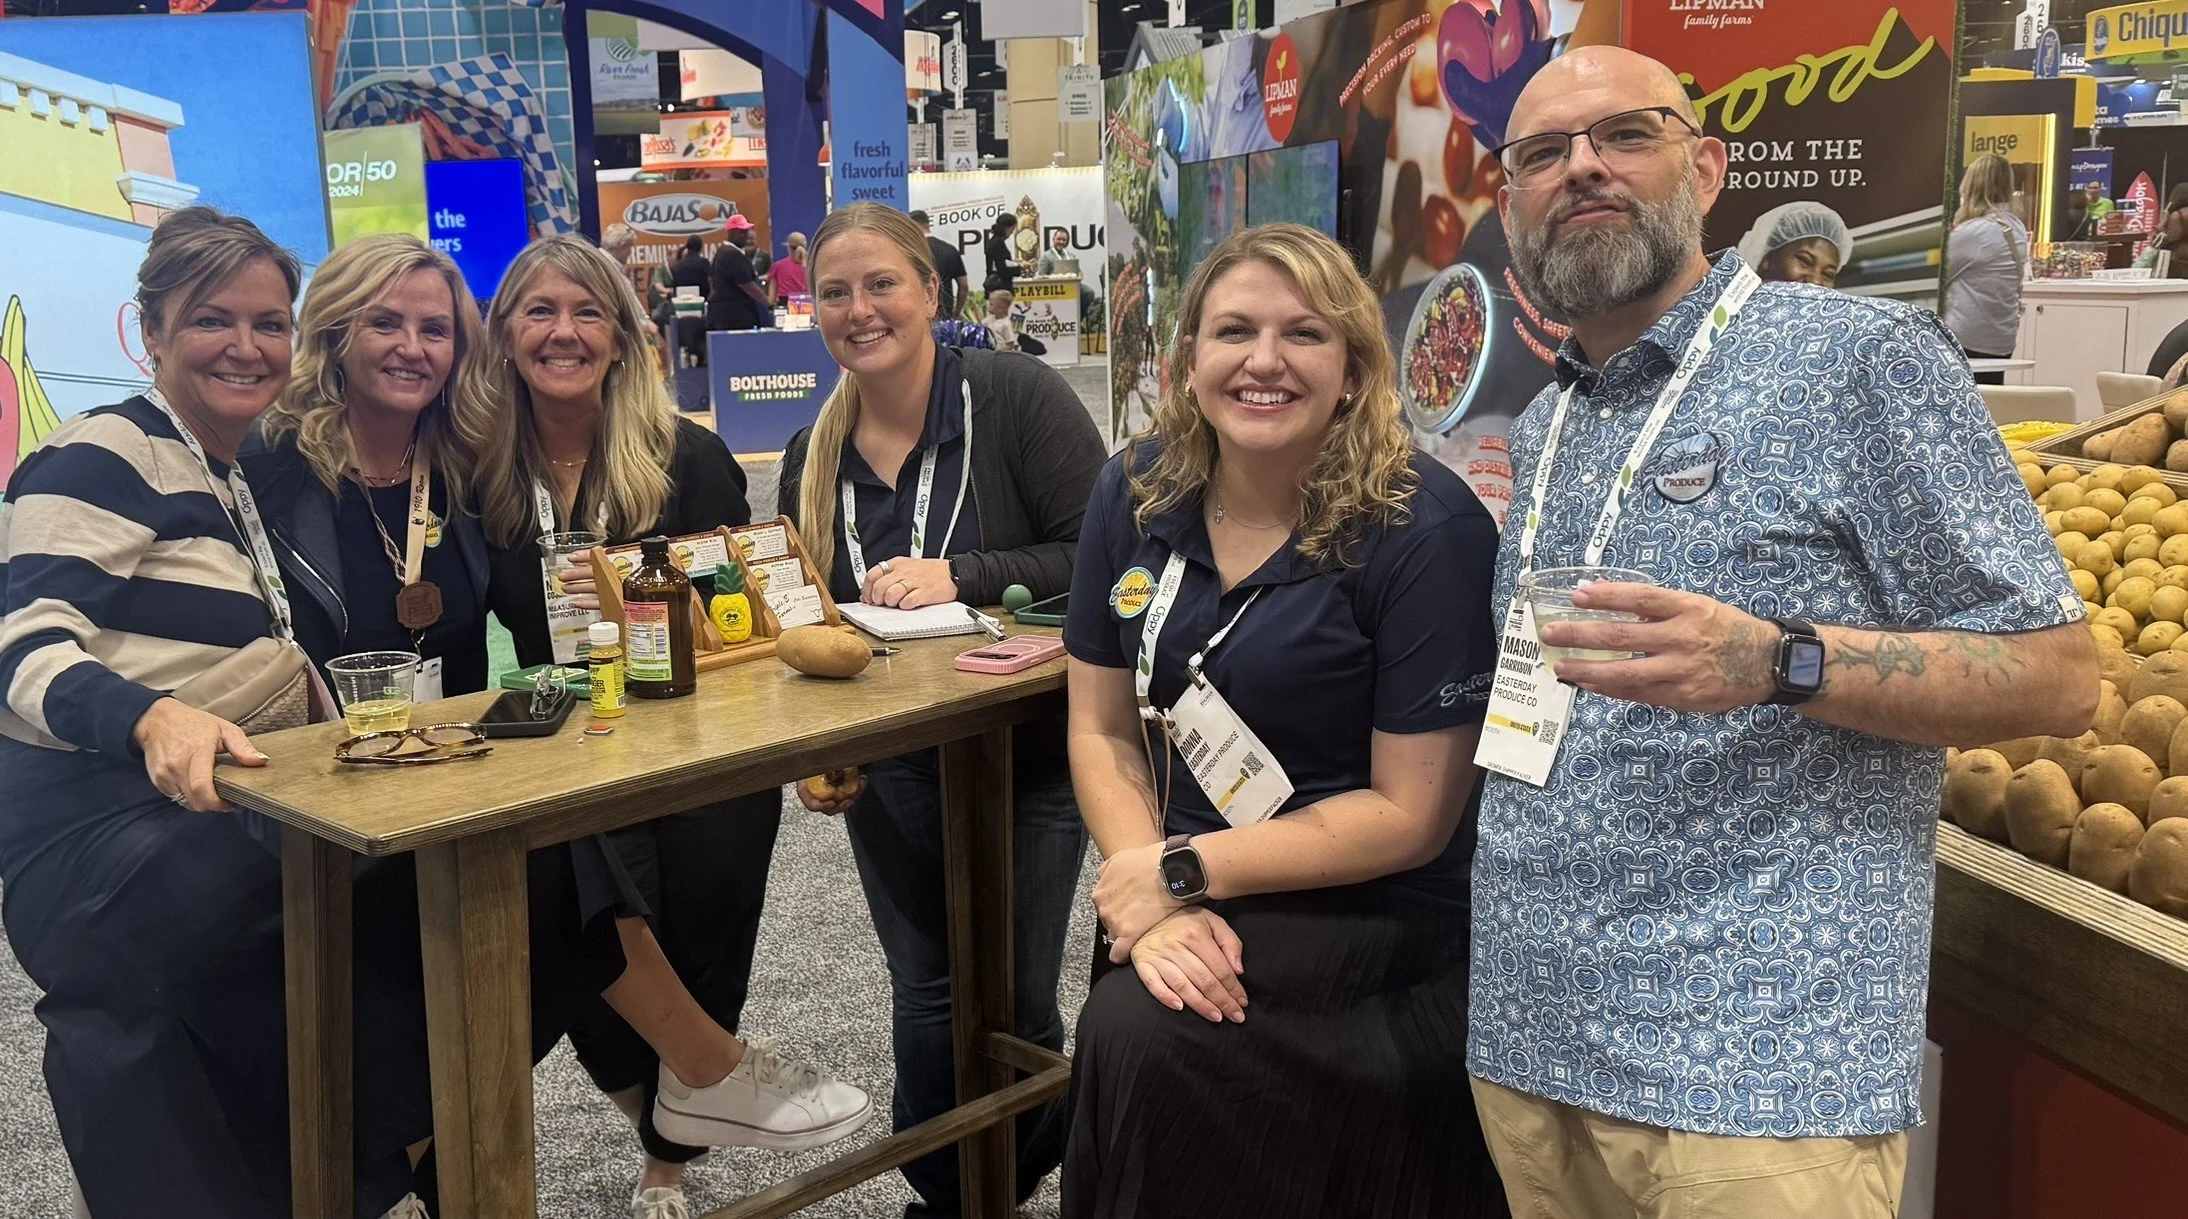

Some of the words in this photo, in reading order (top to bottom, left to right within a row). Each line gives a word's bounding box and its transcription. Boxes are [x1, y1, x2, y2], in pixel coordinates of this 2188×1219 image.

[1684, 14, 1718, 30] family
[1719, 14, 1753, 30] farms
[1398, 43, 1417, 61] NEED
[1265, 78, 1298, 103] LIPMAN
[1339, 62, 1368, 108] PRECISION
[853, 140, 891, 158] fresh
[1722, 140, 1794, 162] ROM
[1806, 139, 1863, 161] THE
[841, 160, 904, 179] flavorful
[1830, 169, 1867, 187] UP.
[328, 184, 360, 197] 2024
[851, 184, 896, 201] sweet
[434, 208, 467, 229] the
[939, 208, 982, 226] BOOK
[985, 203, 1006, 218] OF
[1012, 284, 1066, 298] PLAYBILL
[1676, 346, 1702, 380] Oppy
[730, 372, 817, 392] BOLTHOUSE
[744, 391, 773, 401] FRESH
[774, 390, 804, 400] FOODS
[1663, 477, 1706, 488] PRODUCE
[238, 489, 252, 514] Oppy
[414, 495, 424, 513] 1910
[540, 496, 551, 518] Oppy
[917, 493, 928, 518] Oppy
[1593, 511, 1614, 548] Oppy
[853, 550, 863, 573] Oppy
[1110, 582, 1159, 605] Easterday
[1120, 598, 1142, 607] PRODUCE
[1147, 605, 1166, 636] Oppy
[1503, 635, 1541, 661] MASON
[1500, 656, 1534, 676] GARRISON
[1496, 674, 1538, 694] EASTERDAY
[1493, 686, 1527, 705] PRODUCE
[1526, 694, 1538, 708] CO
[1179, 727, 1203, 760] DONNA
[1188, 741, 1211, 772] EASTERDAY
[1197, 753, 1221, 783] EASTERDAY
[1217, 730, 1240, 758] PRODUCE
[1202, 781, 1212, 792] CO
